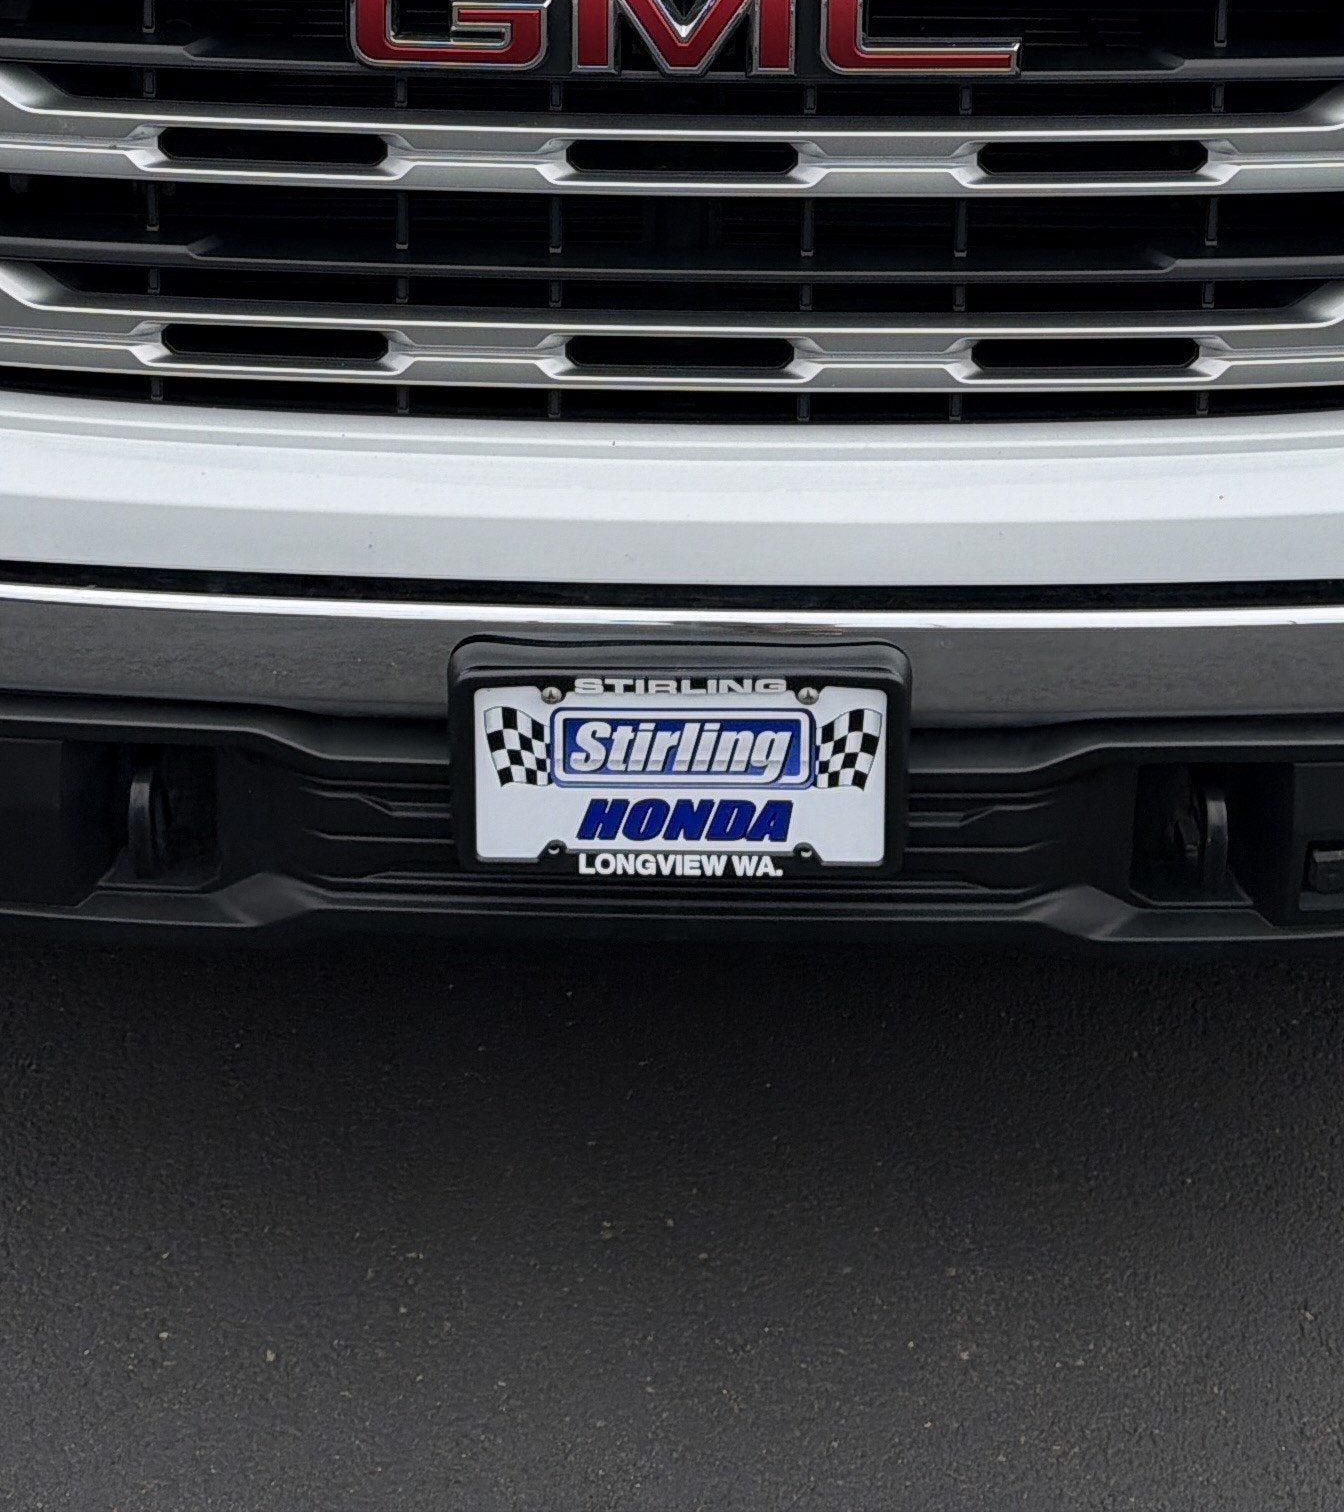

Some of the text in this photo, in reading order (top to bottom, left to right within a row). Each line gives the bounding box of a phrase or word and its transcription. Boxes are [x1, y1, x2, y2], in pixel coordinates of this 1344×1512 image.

[574, 678, 787, 694] STIRLING
[569, 721, 793, 784] Stirling
[576, 798, 794, 842] HONDA
[578, 853, 783, 877] LONGVIEW WA.
